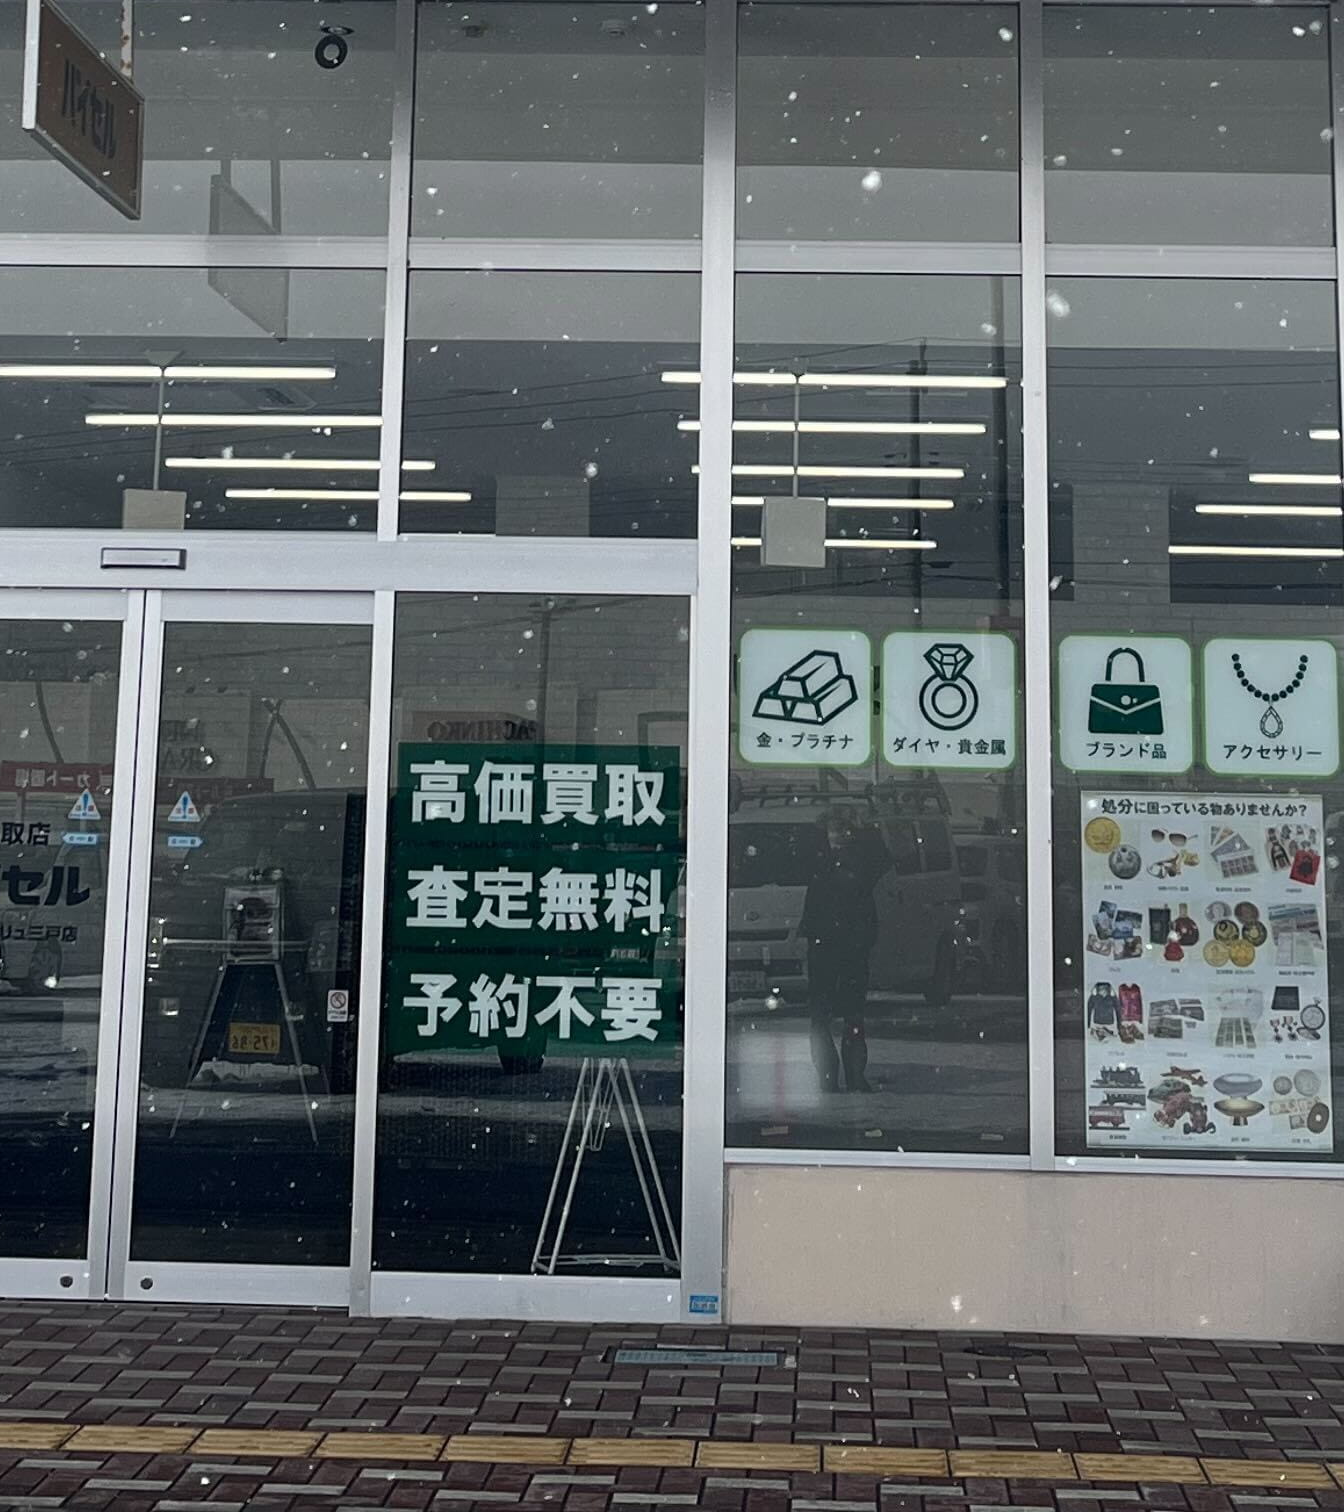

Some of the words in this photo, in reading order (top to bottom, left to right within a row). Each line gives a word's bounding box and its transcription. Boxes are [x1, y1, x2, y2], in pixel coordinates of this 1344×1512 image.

[893, 736, 1006, 756] ダイヤ・貴金属
[1086, 742, 1167, 760] ブランド品
[1223, 743, 1322, 761] アクセサリー
[410, 760, 666, 826] 高価買取
[406, 865, 665, 933] 査定無料
[403, 973, 662, 1042] 予約不要
